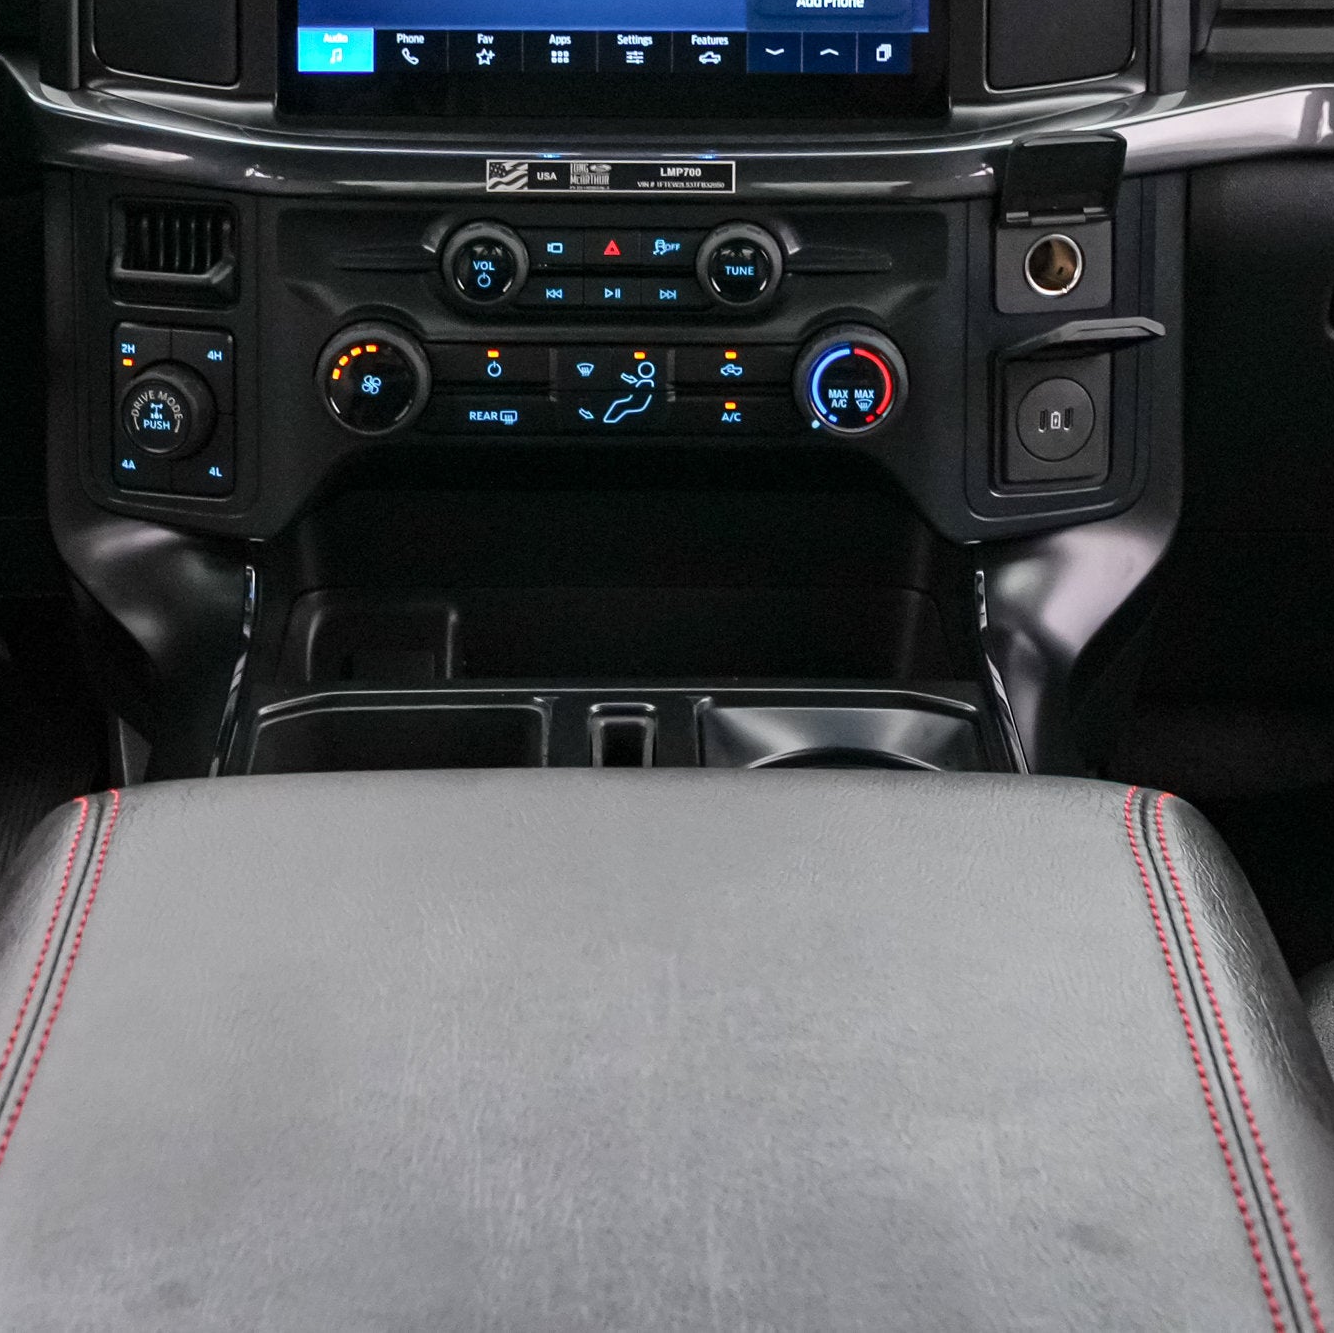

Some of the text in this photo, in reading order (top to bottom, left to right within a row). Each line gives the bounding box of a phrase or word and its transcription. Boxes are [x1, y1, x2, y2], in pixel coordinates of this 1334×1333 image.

[396, 33, 425, 45] Phone
[476, 33, 494, 45] Fav
[549, 33, 572, 47] Apps
[616, 33, 653, 47] Settings
[690, 34, 729, 47] Features
[537, 172, 557, 181] USA
[660, 167, 702, 177] LMP700
[664, 242, 681, 252] OFF
[473, 261, 495, 271] VOL
[725, 266, 754, 276] TUNE
[121, 343, 136, 354] 2H
[207, 349, 222, 361] 4H
[828, 389, 848, 399] MAX
[854, 389, 875, 399] MAX
[131, 390, 183, 421] DRIVE MODE
[831, 399, 848, 408] A/C
[469, 411, 498, 422] REAR
[721, 412, 741, 423] A/C
[143, 419, 170, 430] PUSH
[122, 459, 136, 470] 4A
[209, 467, 222, 477] 4L
